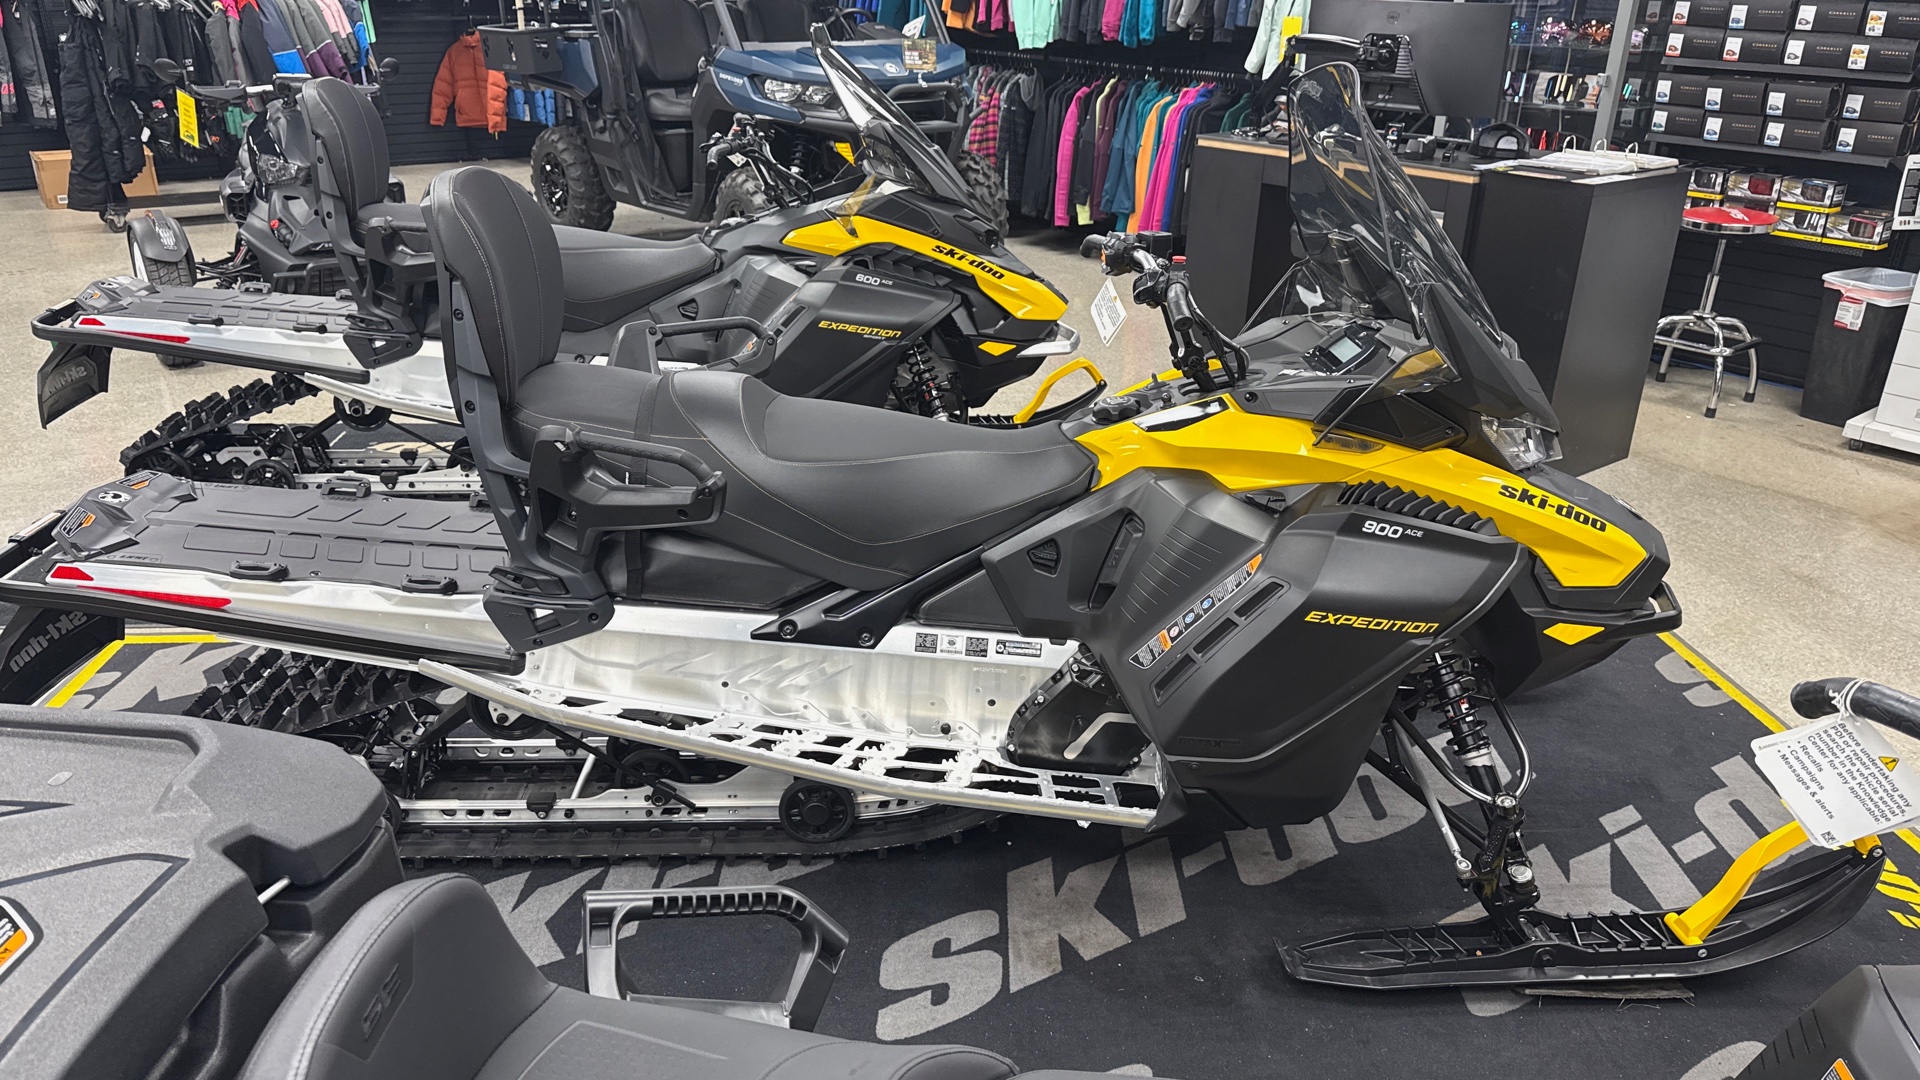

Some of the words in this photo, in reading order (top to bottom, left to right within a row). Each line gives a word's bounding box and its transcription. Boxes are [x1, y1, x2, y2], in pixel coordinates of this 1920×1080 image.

[855, 273, 881, 286] 600
[931, 244, 1006, 280] ski-doo
[818, 320, 902, 338] EXPEDITION
[1361, 520, 1404, 538] 900
[1404, 528, 1424, 538] ACE
[1498, 484, 1608, 533] ski-doo
[1304, 610, 1440, 634] EXPEDITION
[1789, 749, 1826, 791] Campaigns
[1800, 744, 1824, 773] Recalls
[1807, 735, 1830, 760] Center
[1827, 759, 1838, 770] for
[1837, 771, 1851, 786] any
[1848, 786, 1884, 826] applicable:
[1815, 732, 1842, 762] number
[1838, 760, 1848, 770] in
[1845, 768, 1858, 782] the
[1855, 781, 1892, 823] Knowledge
[1822, 728, 1846, 757] search
[1844, 754, 1857, 769] the
[1856, 768, 1880, 796] vehicle
[1879, 795, 1900, 818] serial
[1830, 725, 1845, 740] PDI
[1842, 739, 1852, 749] or
[1850, 748, 1872, 772] repair
[1868, 772, 1906, 817] procedures,
[1838, 722, 1860, 748] Before
[1860, 747, 1900, 794] undertaking
[1898, 792, 1912, 808] any
[1779, 754, 1812, 791] Messages
[1809, 790, 1818, 798] &
[1815, 798, 1835, 820] alerts
